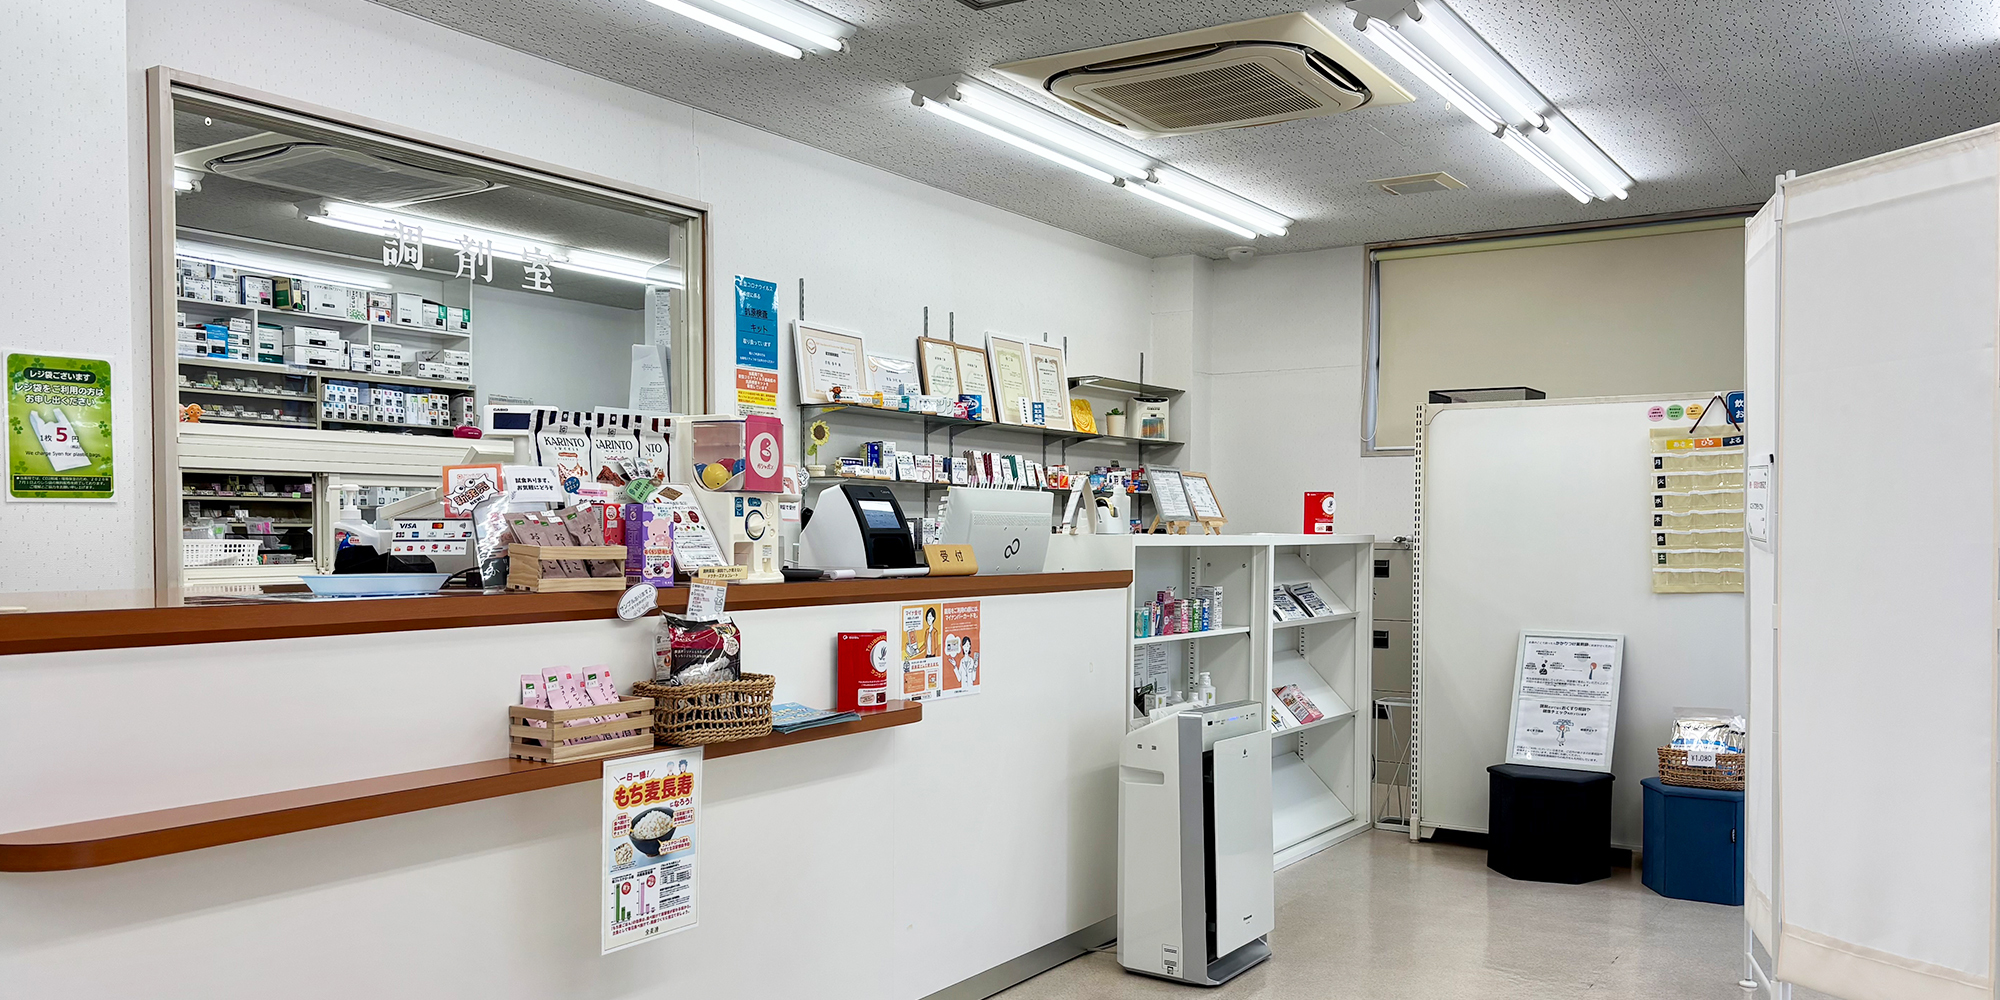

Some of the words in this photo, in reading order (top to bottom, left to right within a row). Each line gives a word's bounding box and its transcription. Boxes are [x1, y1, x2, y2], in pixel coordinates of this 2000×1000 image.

[382, 218, 554, 293] 調剤室
[750, 323, 768, 334] キット
[29, 370, 91, 381] レジ袋ございます
[14, 382, 104, 397] レジ袋をご利用の方は
[25, 394, 95, 406] お申し出ください
[40, 435, 52, 443] 1枚
[56, 427, 68, 442] 5
[543, 436, 585, 448] KARINTO
[1701, 438, 1714, 446] ひる
[1657, 477, 1665, 485] 火
[453, 481, 490, 505] 新発売
[940, 550, 964, 563] 受付
[614, 774, 693, 807] もち麦長寿
[669, 797, 693, 808] になろう!
